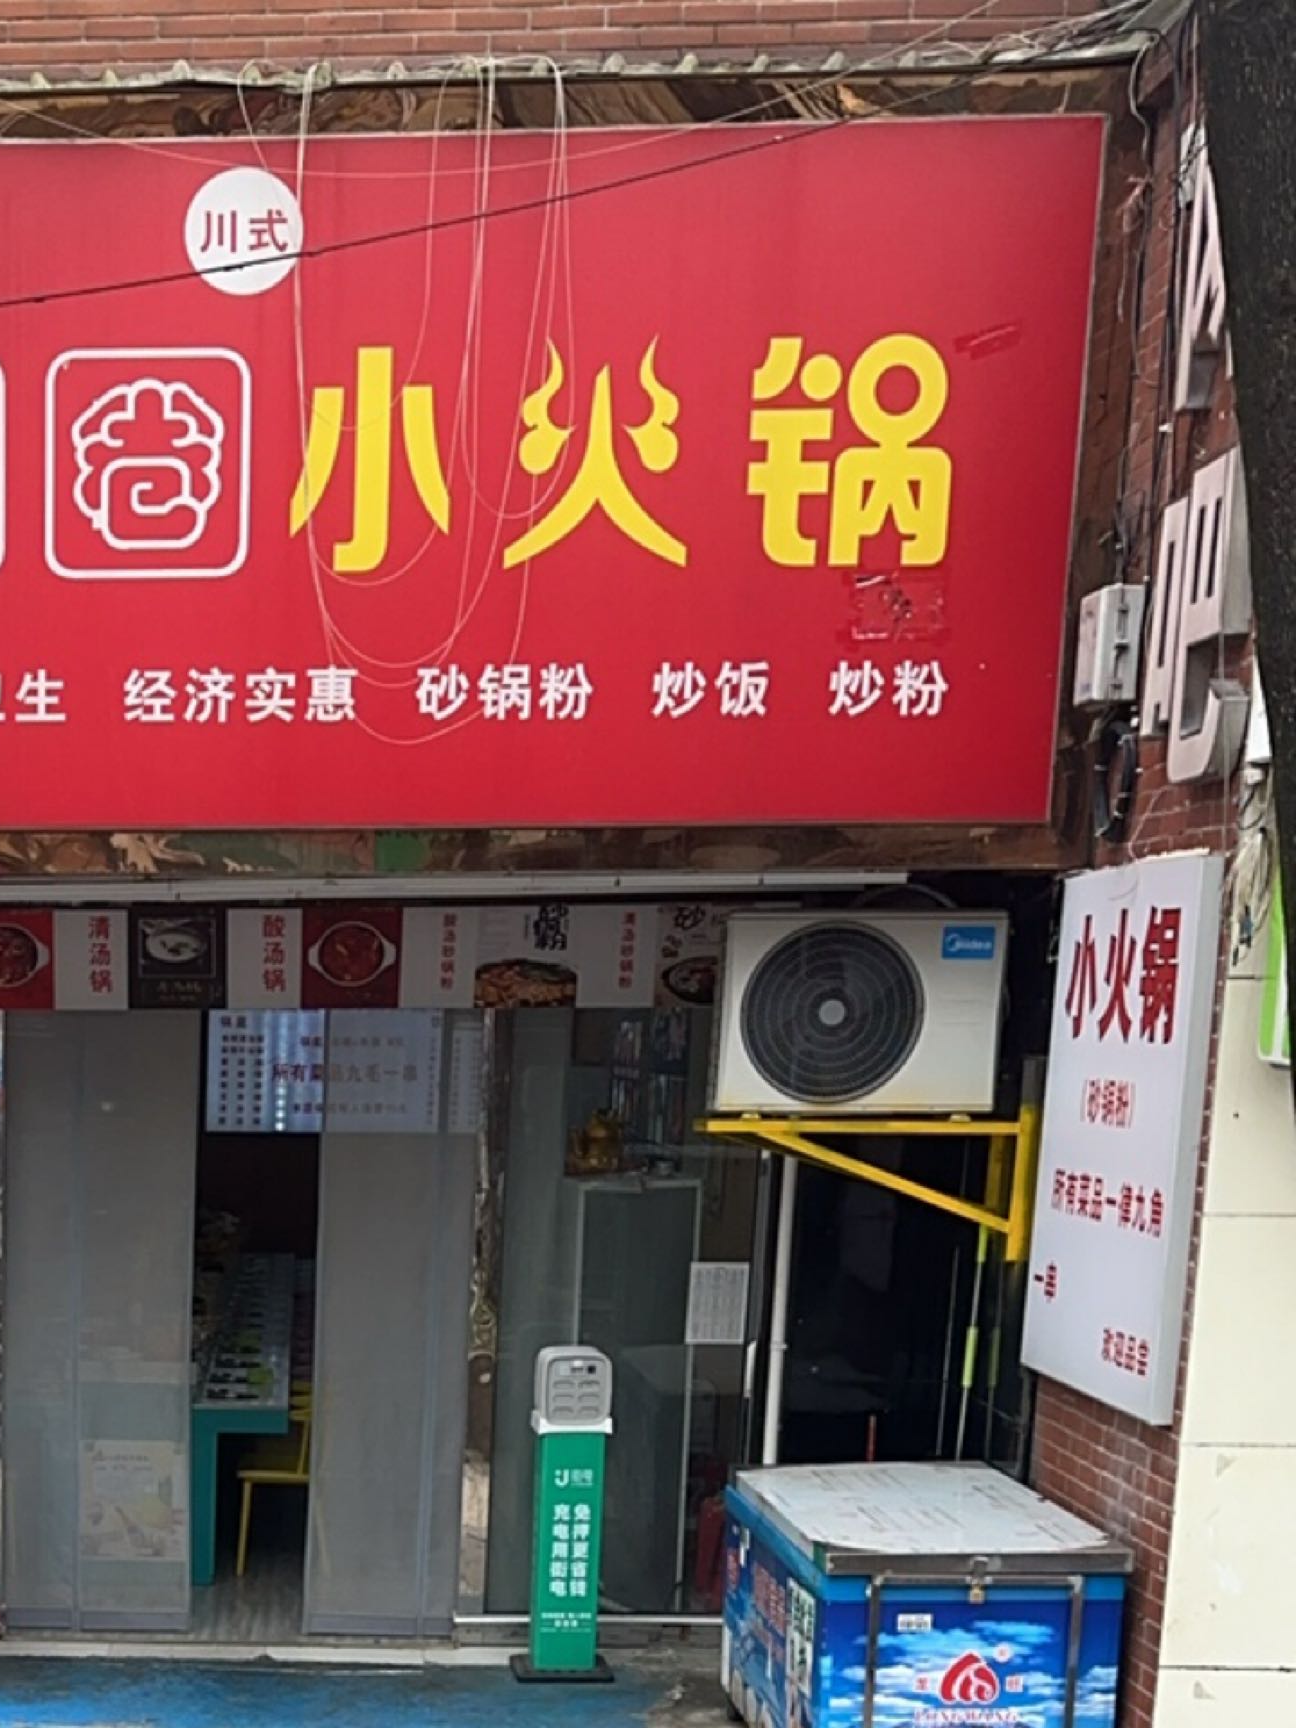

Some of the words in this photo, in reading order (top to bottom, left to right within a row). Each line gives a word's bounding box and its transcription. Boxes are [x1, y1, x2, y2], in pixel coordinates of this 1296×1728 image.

[200, 208, 289, 256] 川式
[123, 666, 357, 725] 经济实惠
[415, 664, 593, 721] 砂锅粉
[652, 661, 770, 719] 炒饭
[829, 659, 949, 718] 炒粉
[87, 914, 114, 994] 清汤锅
[261, 914, 287, 993] 酸汤锅
[1065, 905, 1182, 1044] 小火锅
